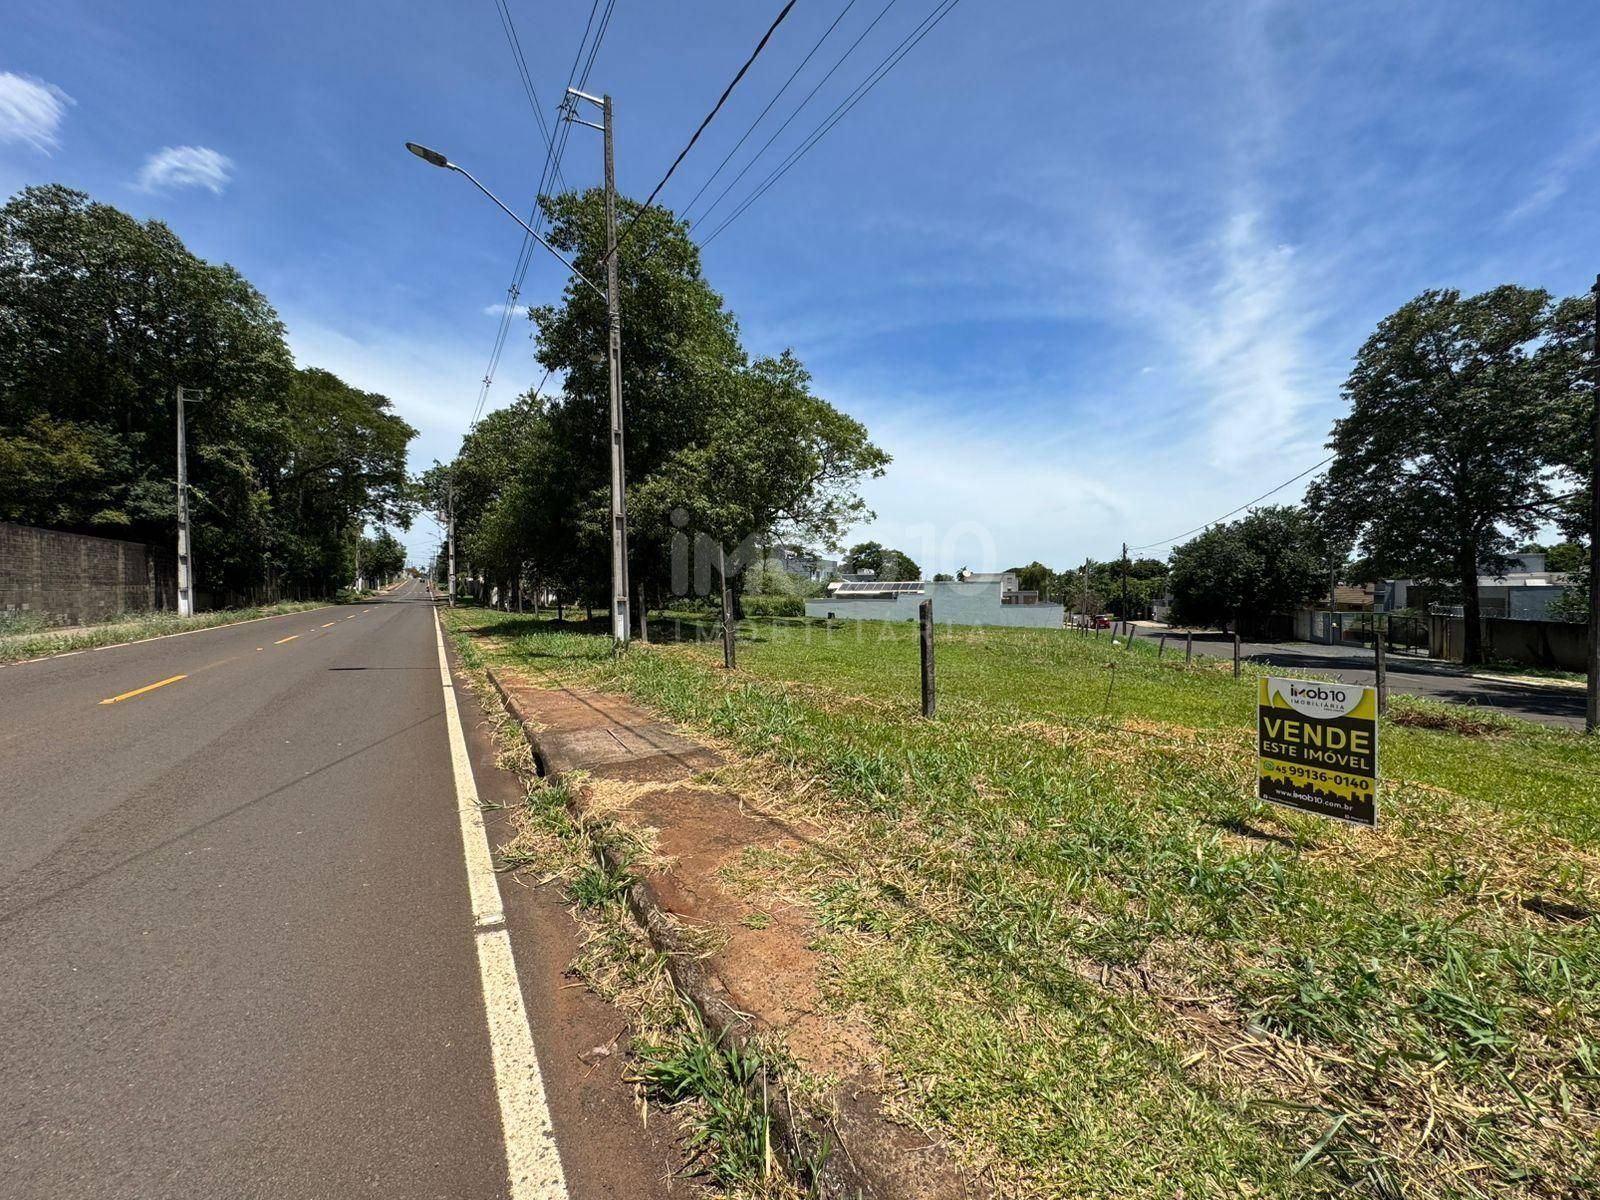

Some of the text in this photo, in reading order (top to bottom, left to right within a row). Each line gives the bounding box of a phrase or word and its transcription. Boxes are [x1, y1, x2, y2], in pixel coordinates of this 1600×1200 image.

[1263, 716, 1370, 754] VENDE
[1263, 740, 1370, 770] ESTE IMÓVEL
[1275, 765, 1369, 791] 45 99136-0140
[1275, 788, 1354, 812] www.imob10.com.br
